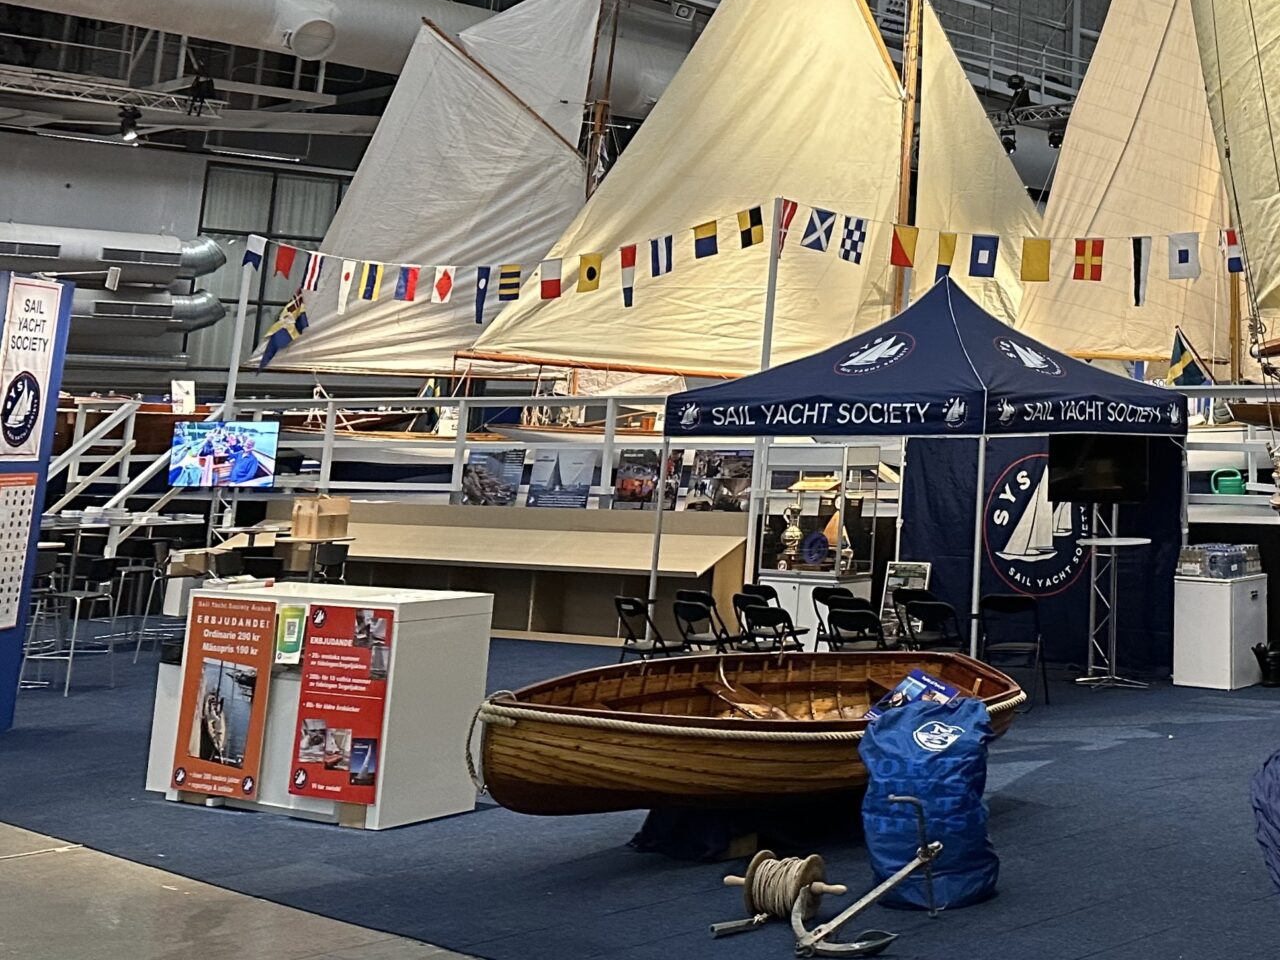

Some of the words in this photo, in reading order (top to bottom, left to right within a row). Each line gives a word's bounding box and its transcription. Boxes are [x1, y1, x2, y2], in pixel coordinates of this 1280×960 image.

[24, 298, 45, 315] SAIL
[18, 317, 47, 334] YACHT
[10, 335, 49, 353] SOCIETY
[711, 406, 755, 426] SAIL
[761, 403, 832, 425] YACHT
[836, 402, 931, 424] SOCIETY
[1024, 401, 1055, 421] SAIL
[1059, 401, 1104, 421] YACHT
[1107, 402, 1161, 423] SOCIETY
[993, 470, 1031, 526] SYS
[1008, 567, 1031, 586] SAIL
[1036, 565, 1072, 587] YACHT
[1072, 505, 1088, 564] SOIETY
[197, 615, 270, 629] ERBJUDANDE!
[203, 629, 236, 640] Ordinarie
[252, 632, 261, 641] kr
[310, 636, 353, 647] ERBJUDANDE
[250, 646, 258, 655] kr
